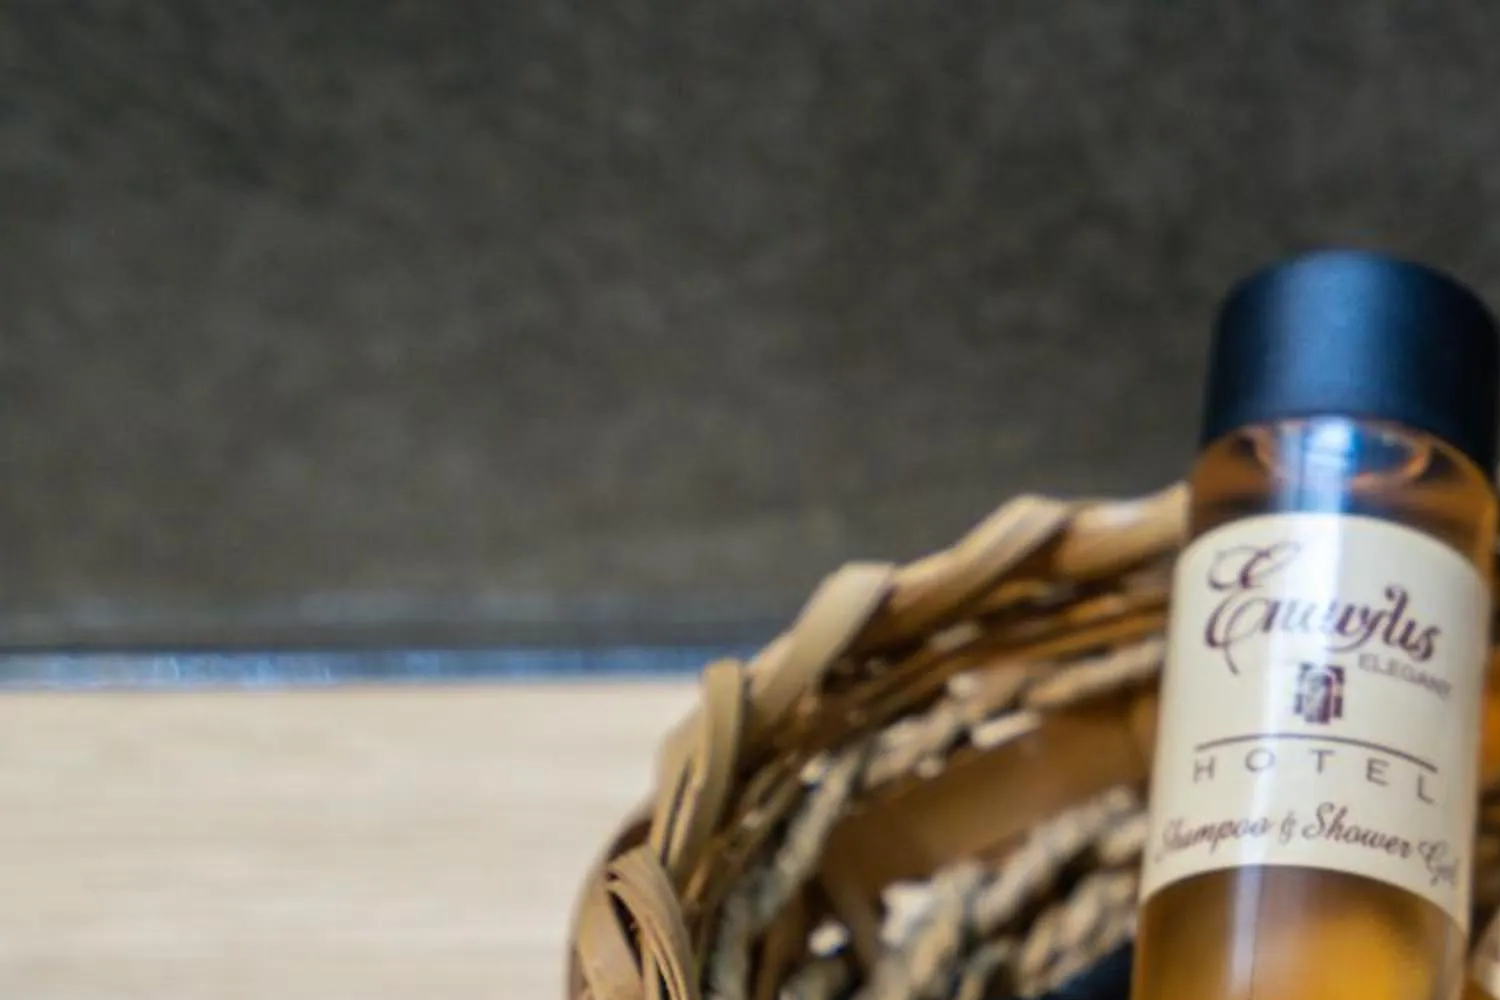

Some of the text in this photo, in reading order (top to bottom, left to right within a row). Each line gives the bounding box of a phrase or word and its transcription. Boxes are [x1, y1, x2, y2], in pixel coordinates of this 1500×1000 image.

[1357, 653, 1452, 697] ELEGANT
[1192, 747, 1438, 803] HOTEL
[1302, 802, 1412, 859] Shower
